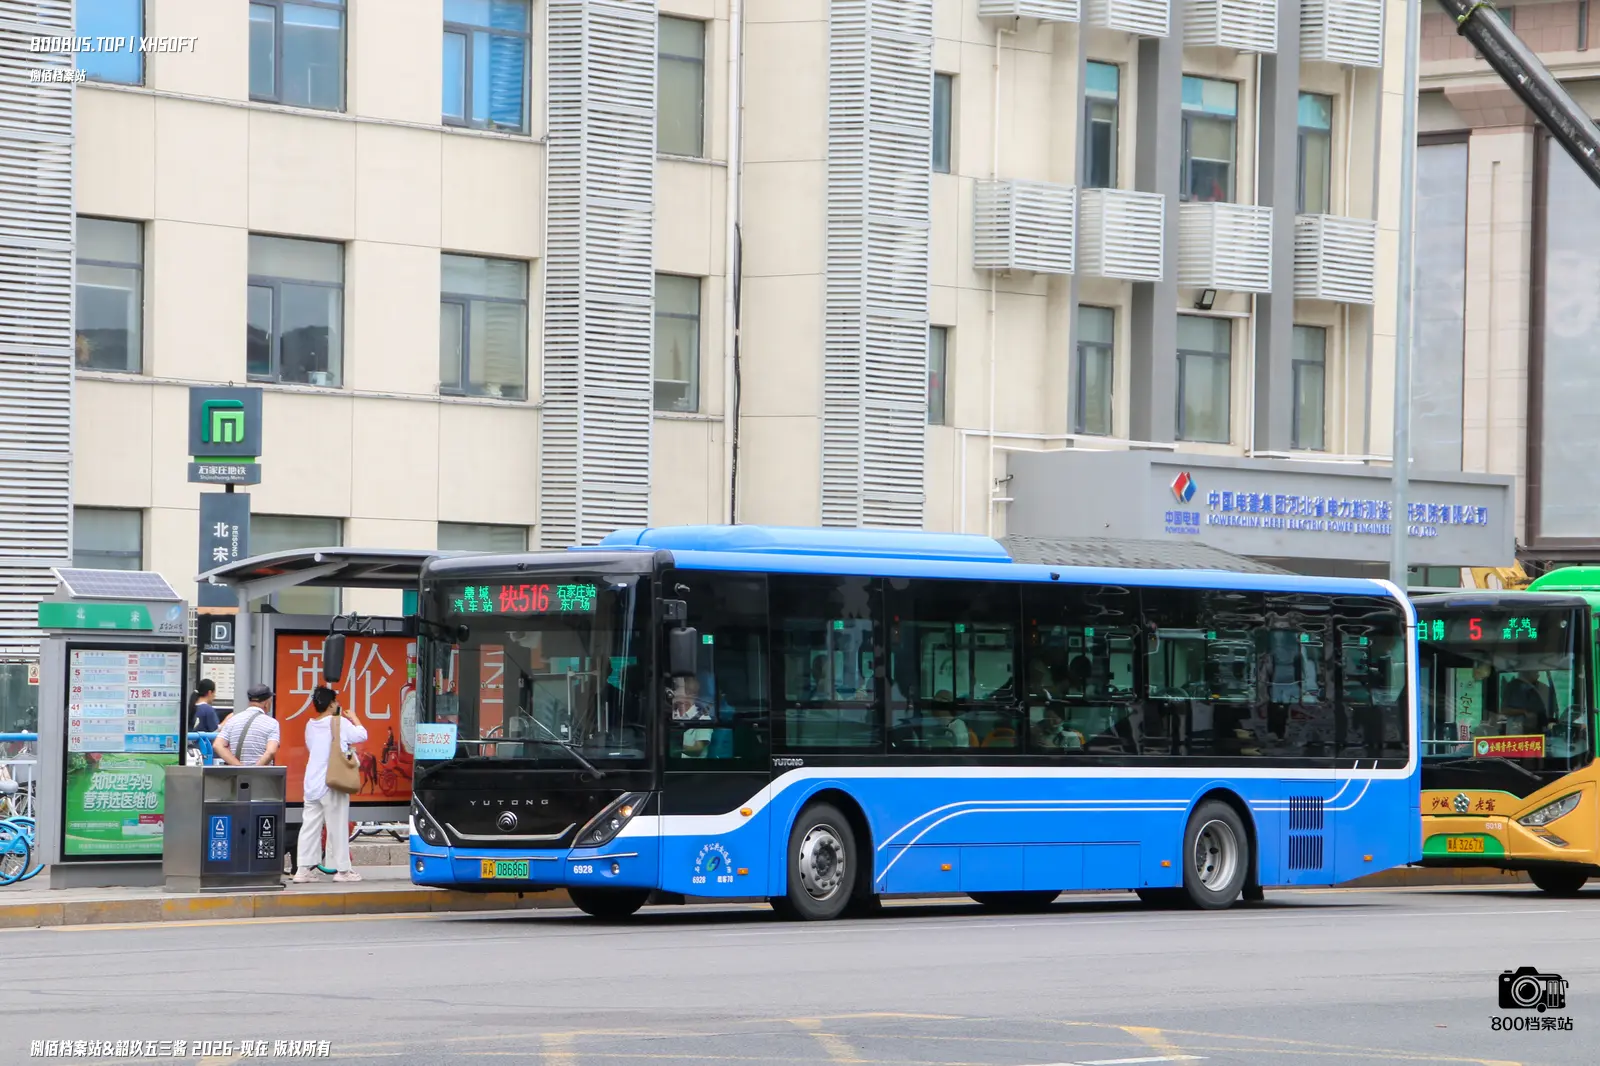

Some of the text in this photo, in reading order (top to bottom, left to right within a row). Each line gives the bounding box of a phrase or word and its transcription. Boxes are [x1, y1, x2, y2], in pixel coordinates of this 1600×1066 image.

[198, 465, 247, 475] 石家庄地铁
[1206, 489, 1489, 526] 中国电建集团河北省电力勘测设究院有限公司
[499, 584, 549, 612] 快516
[556, 584, 597, 599] 石家庄站
[454, 598, 493, 613] 汽车站
[560, 598, 591, 611] 东广场
[1417, 619, 1445, 641] 白佛
[1468, 618, 1483, 641] 5
[1508, 617, 1531, 629] 北站
[216, 624, 228, 640] D
[1503, 628, 1538, 640] 南广场
[285, 640, 395, 721] 英伦
[130, 689, 140, 699] 73
[772, 758, 804, 767] YUTONG
[89, 771, 154, 791] 知识型孕妈
[573, 864, 594, 874] 6928
[692, 876, 707, 884] 6928
